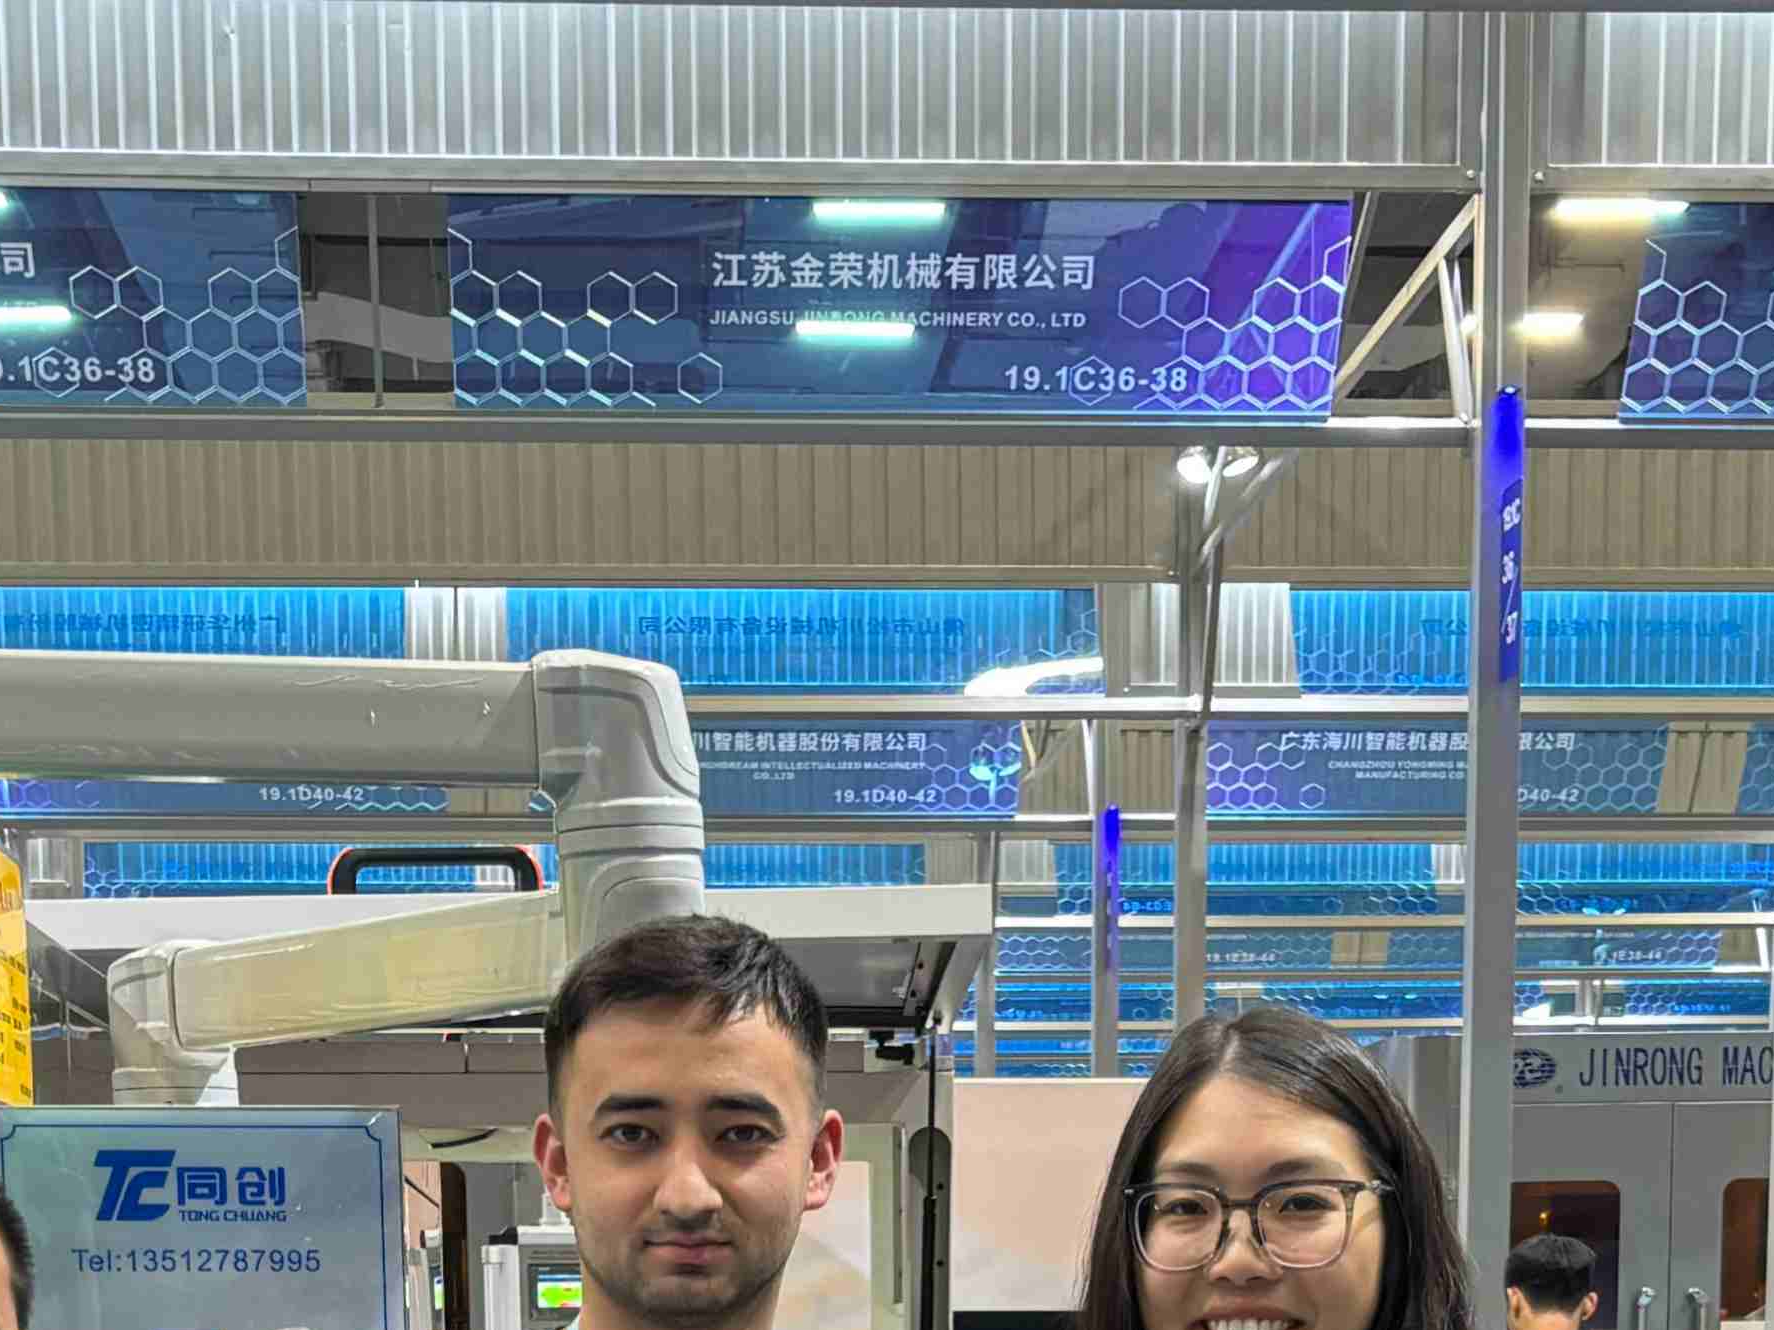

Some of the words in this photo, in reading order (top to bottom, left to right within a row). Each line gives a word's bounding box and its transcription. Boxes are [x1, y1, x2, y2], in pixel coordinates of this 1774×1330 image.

[711, 252, 1096, 291] 江苏金荣机械有限公司
[710, 310, 794, 326] JIANGSU
[892, 311, 1003, 328] MACHINERY
[1051, 313, 1087, 328] LTD
[1004, 366, 1187, 392] 19.1C36-38
[259, 786, 365, 802] 19.1D40-42
[834, 789, 937, 803] 19.1D40-42
[1579, 1048, 1702, 1086] JINRONG
[93, 1149, 176, 1222] TC
[177, 1166, 287, 1207] 同创
[179, 1209, 220, 1223] TONG
[223, 1209, 288, 1223] CHUANG
[71, 1248, 322, 1274] Tel:13512787995
